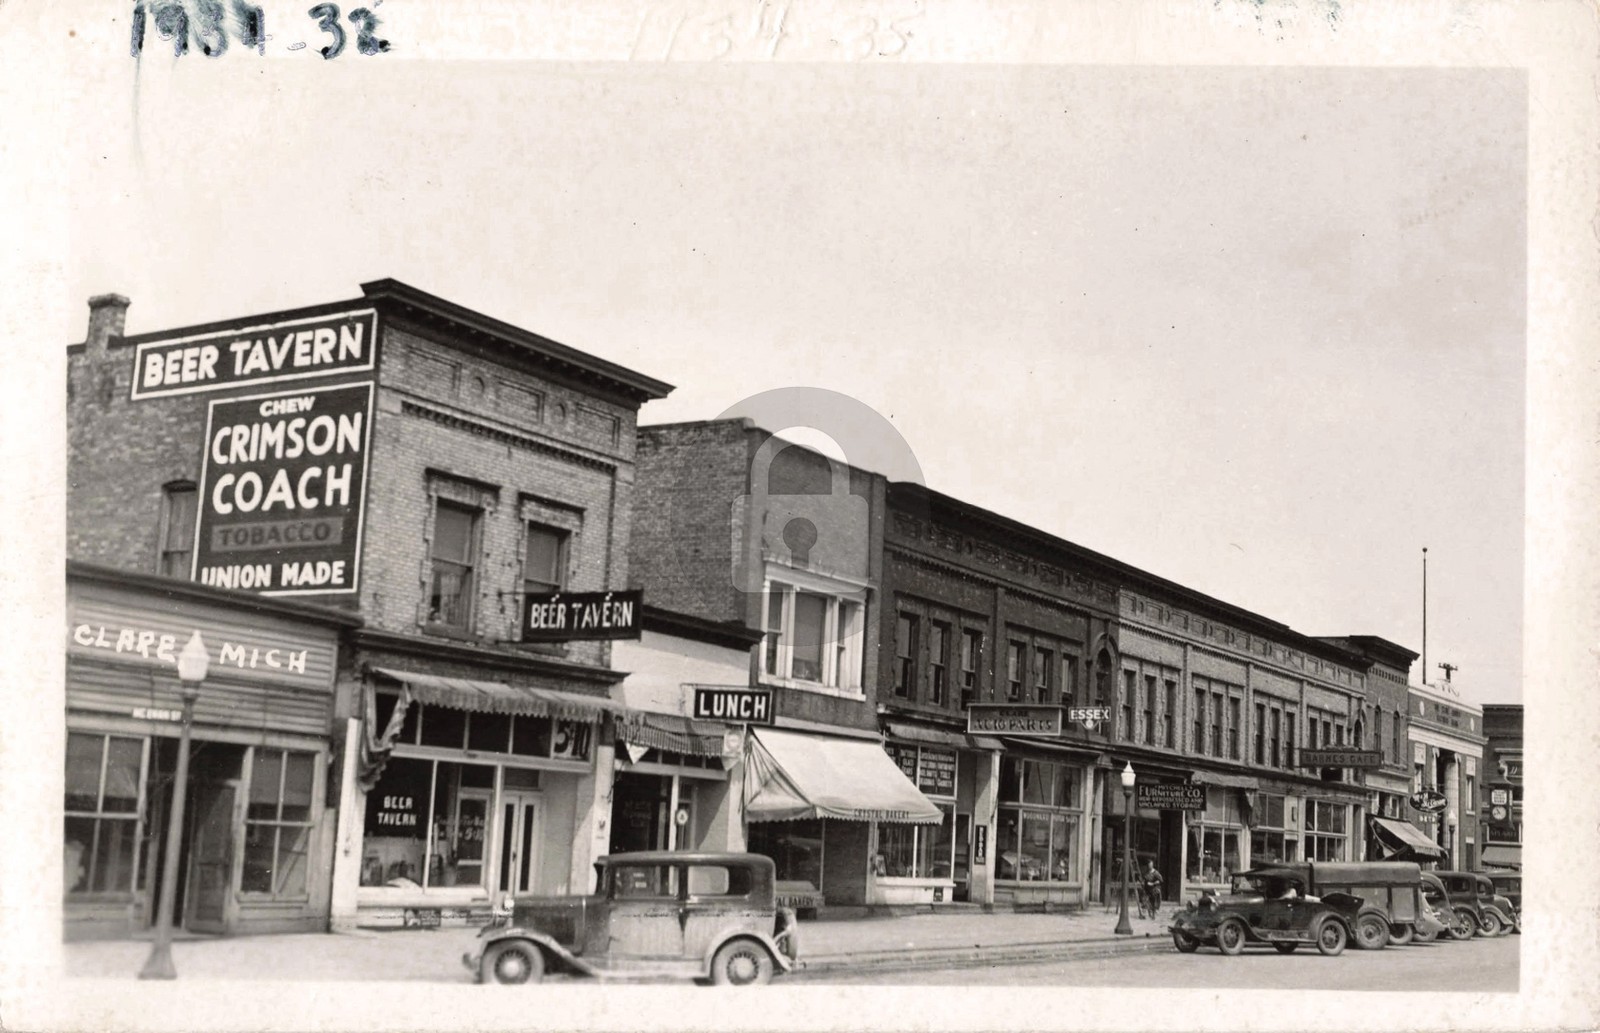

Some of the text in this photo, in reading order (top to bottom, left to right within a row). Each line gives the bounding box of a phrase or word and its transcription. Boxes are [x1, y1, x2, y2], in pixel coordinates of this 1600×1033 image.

[143, 322, 363, 388] BEER TAVERN
[259, 396, 315, 417] CHEW
[212, 412, 363, 464] CRIMSON
[212, 463, 352, 514] COACH
[219, 522, 332, 547] TOBACCO
[201, 561, 345, 589] UNION MADE
[531, 600, 634, 629] BEER TAVERN
[699, 692, 767, 719] LUNCH
[1070, 709, 1110, 720] ESSEX
[1009, 719, 1052, 731] PARTS
[1139, 785, 1204, 798] FURNITURE CO.
[383, 795, 413, 810] BEER
[377, 811, 417, 826] TAVERN
[854, 808, 910, 819] CRYSTAL BAKERY
[788, 895, 815, 908] BAKERY
